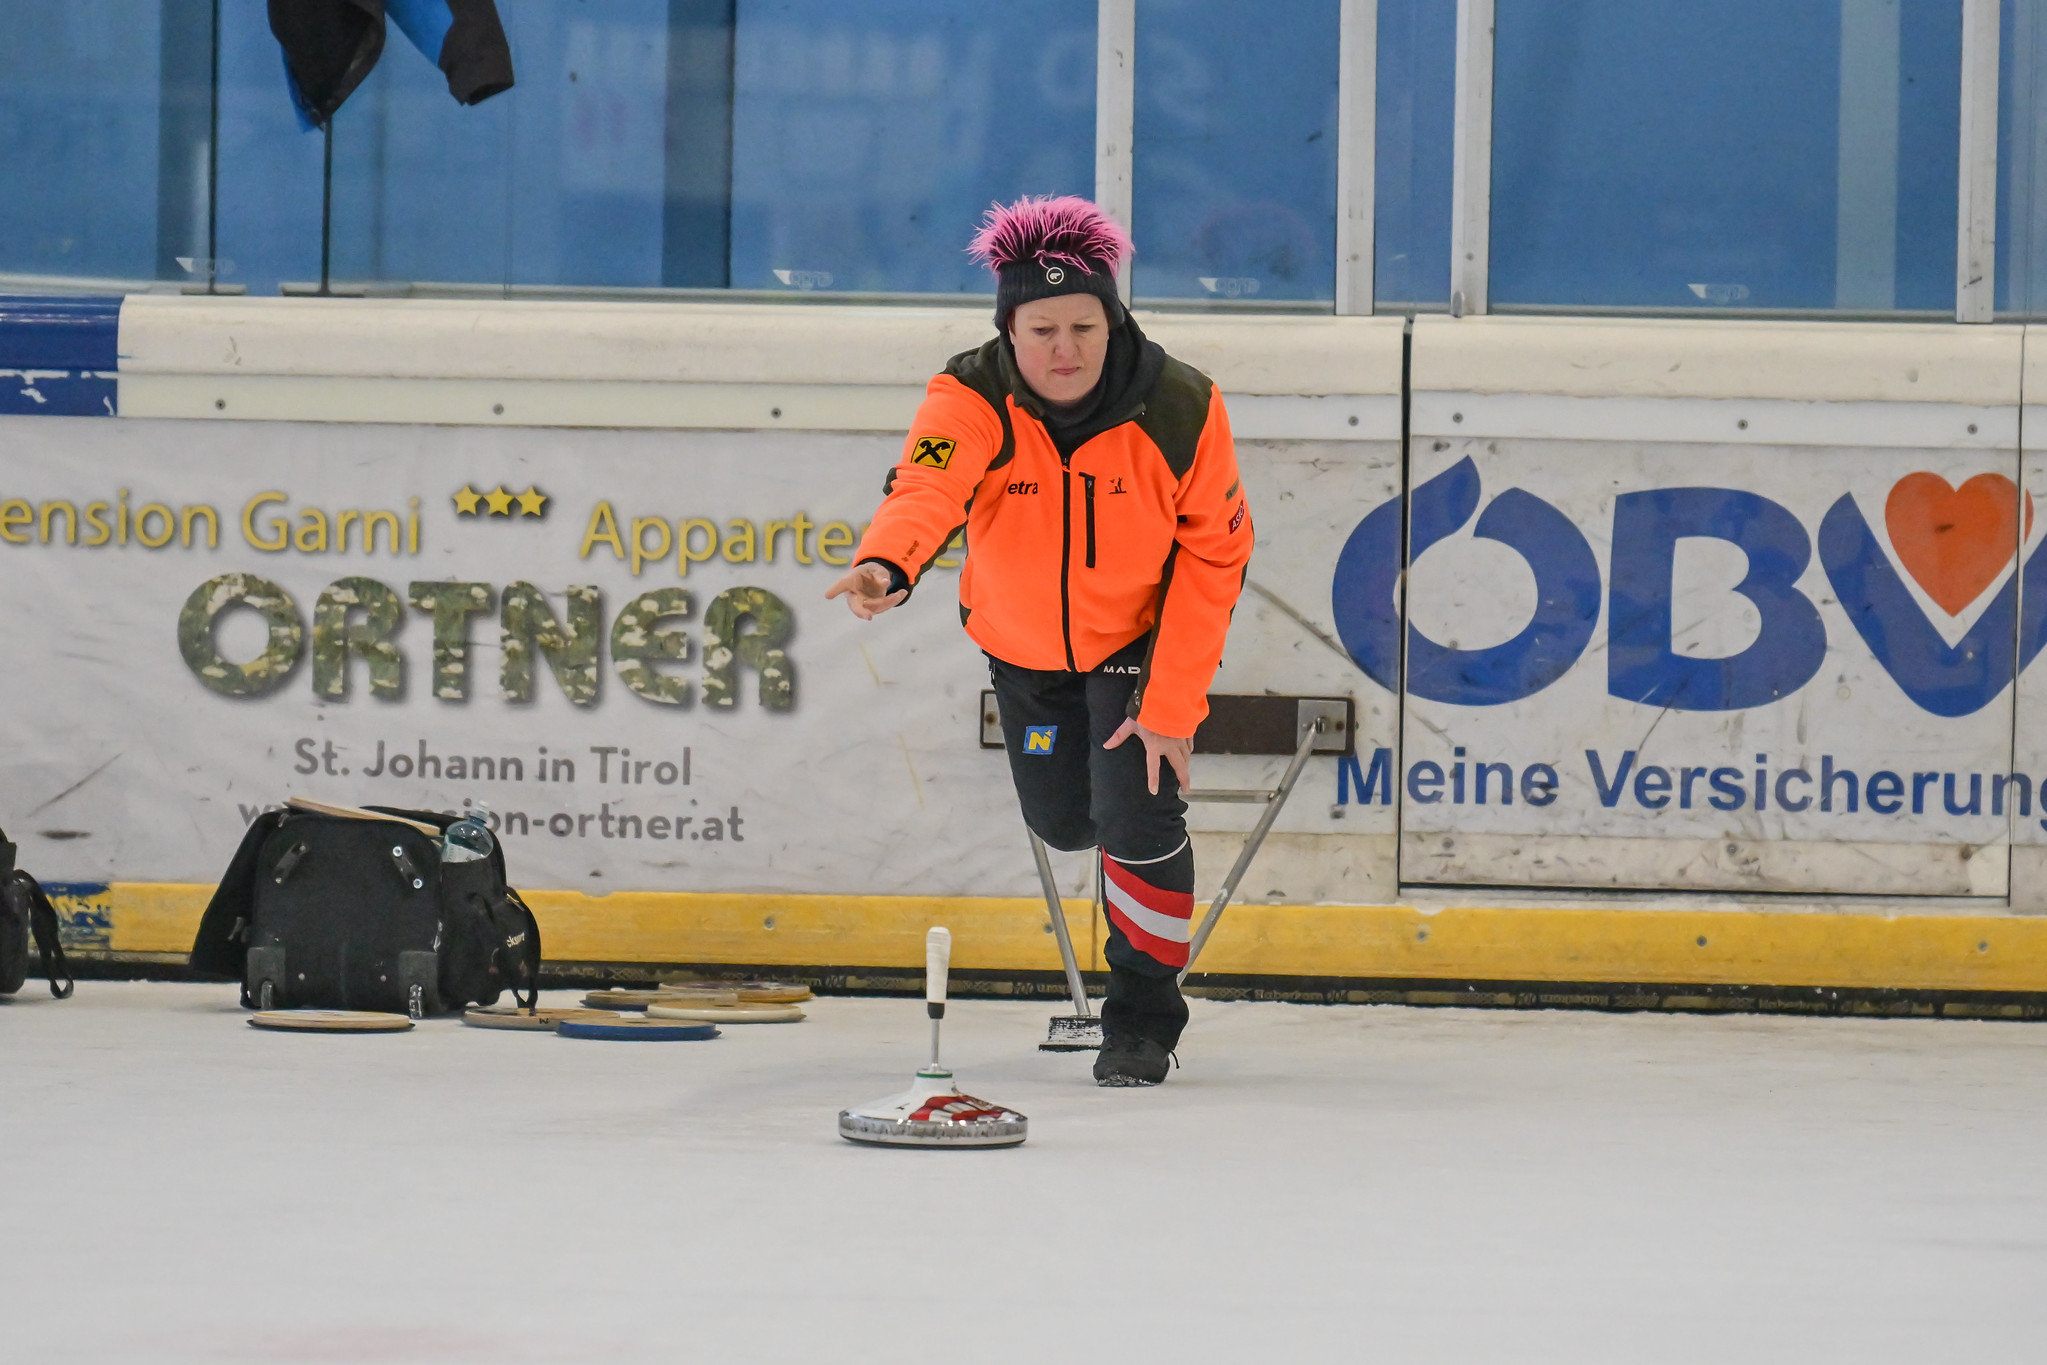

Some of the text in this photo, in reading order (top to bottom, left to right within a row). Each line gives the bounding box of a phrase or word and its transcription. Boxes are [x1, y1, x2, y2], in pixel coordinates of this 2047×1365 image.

[241, 492, 421, 554] Garni
[177, 572, 796, 707] ORTNER
[294, 738, 692, 786] St. Johann in Tirol
[1337, 746, 2047, 832] Meine Versicherun
